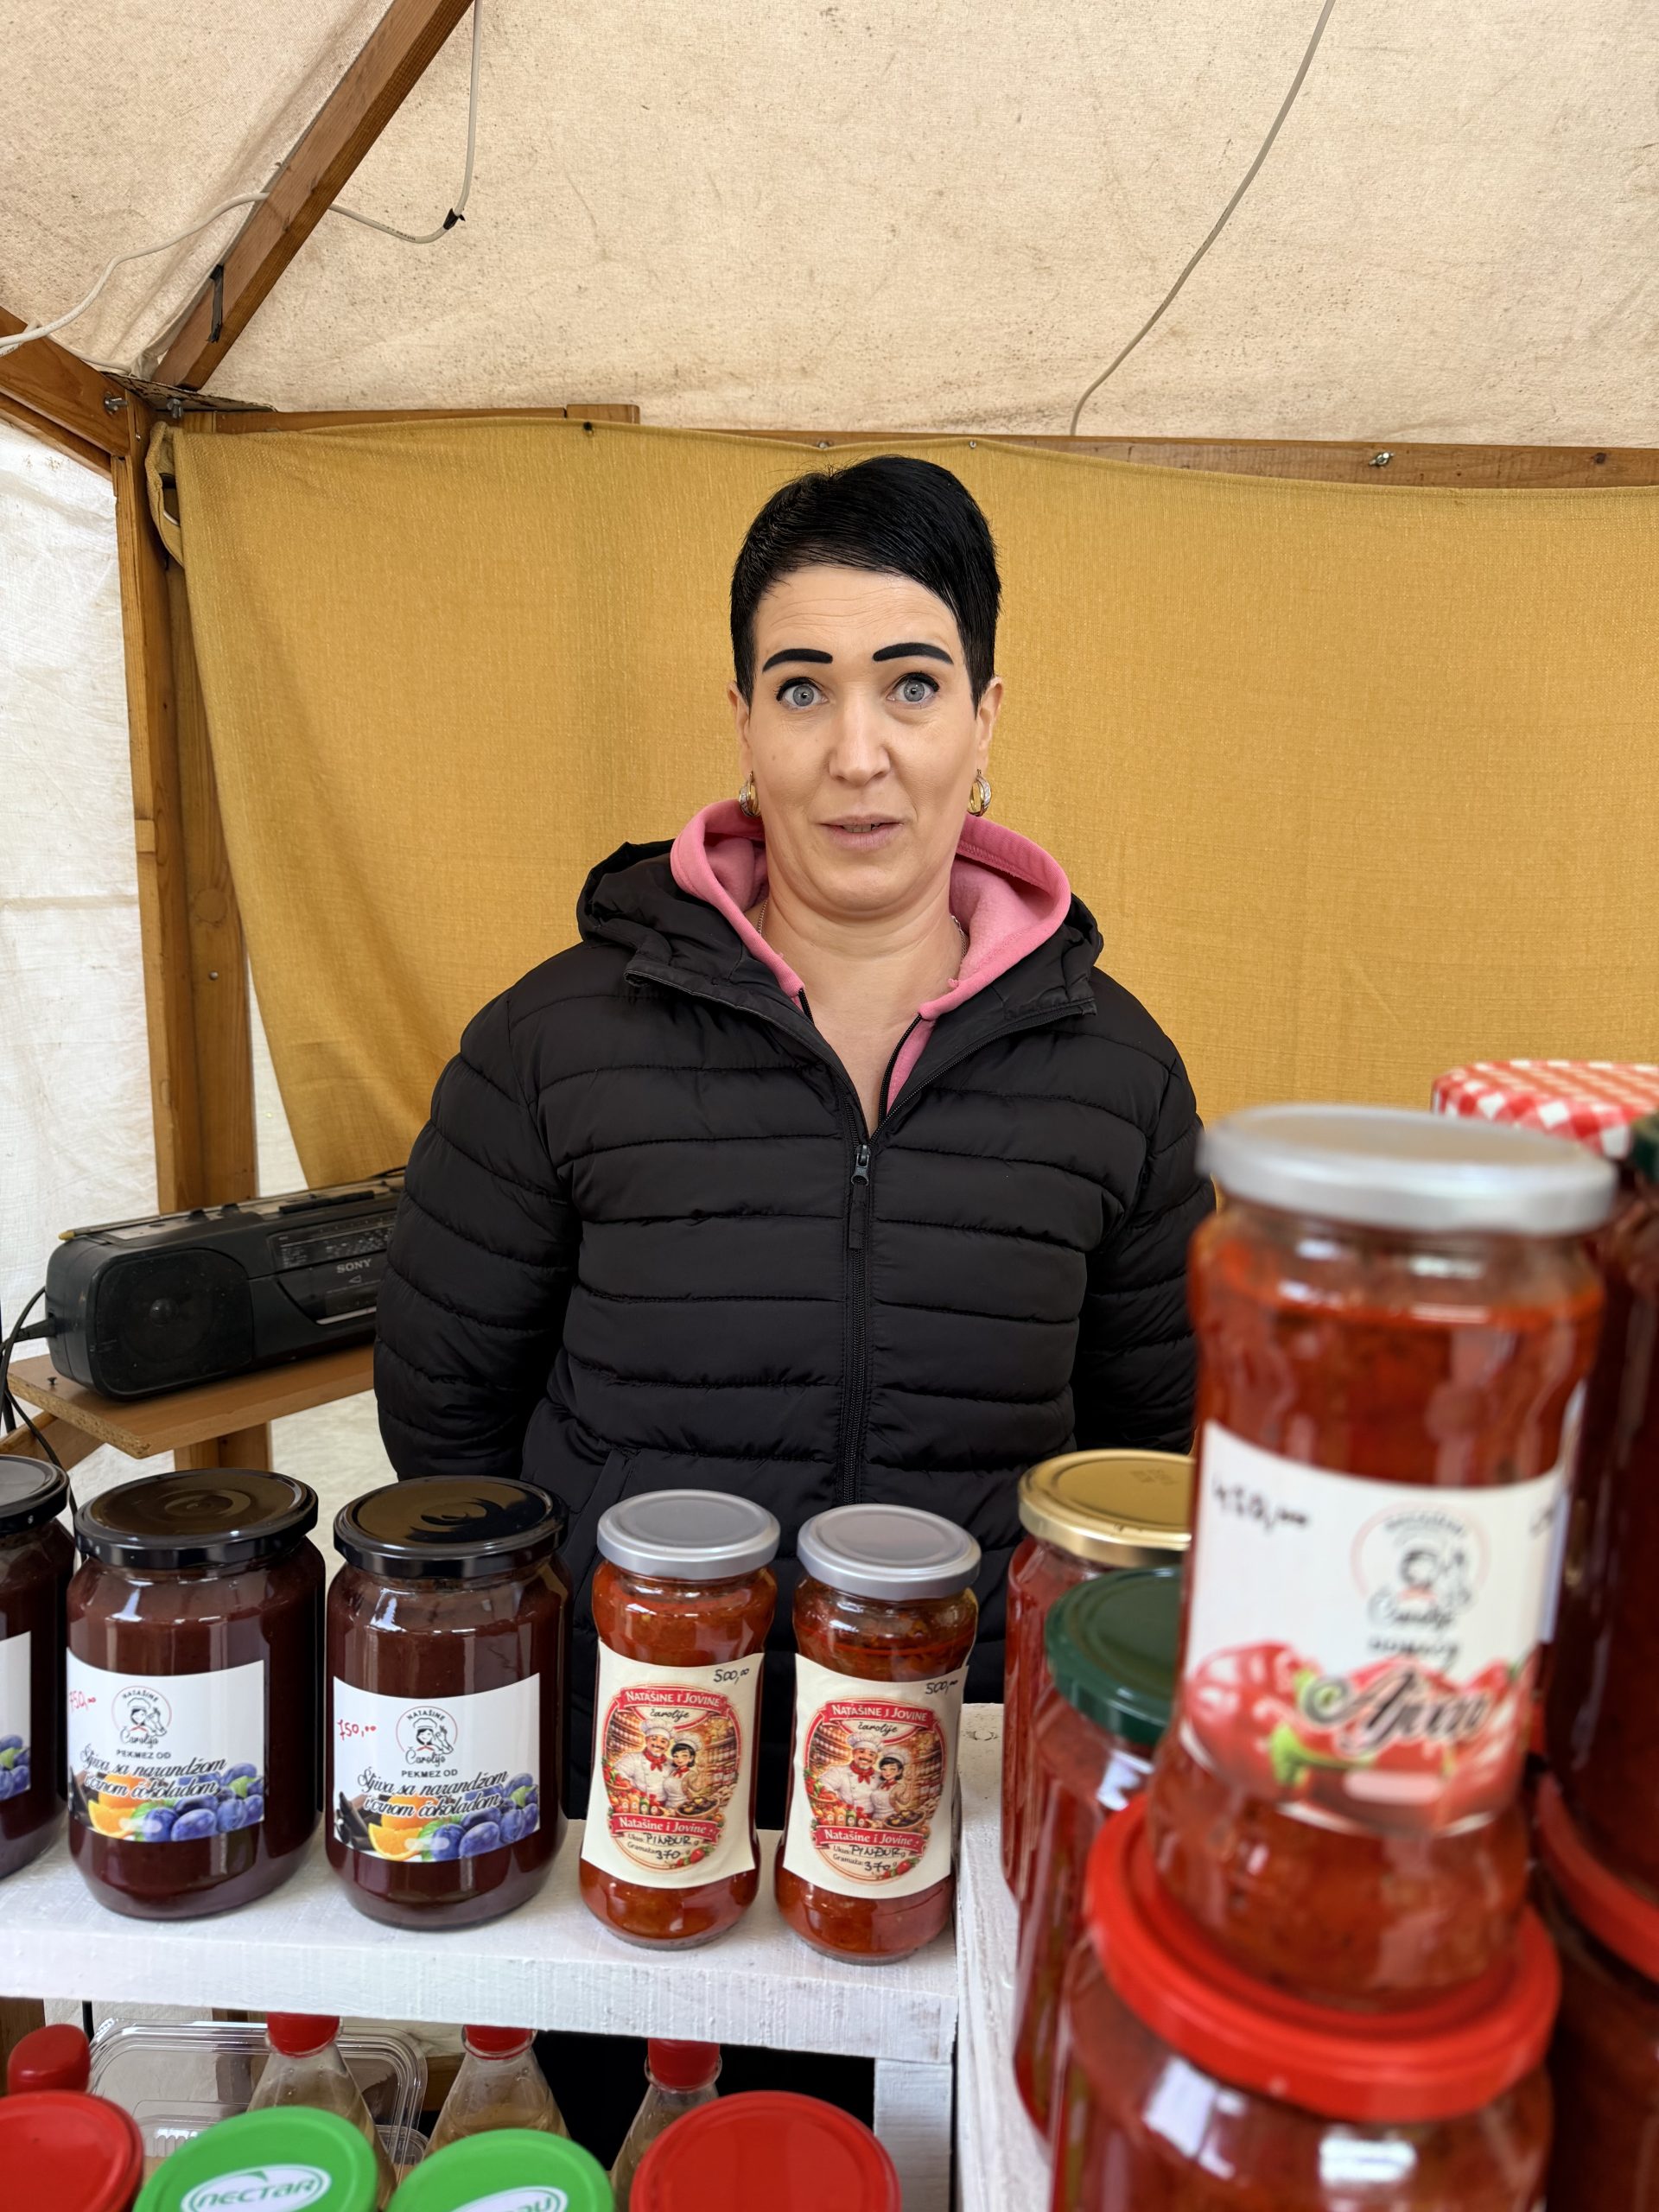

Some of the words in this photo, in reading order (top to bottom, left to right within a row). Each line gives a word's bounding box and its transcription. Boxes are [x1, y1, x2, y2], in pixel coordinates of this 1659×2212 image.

[336, 1258, 372, 1274] SONY
[625, 1690, 673, 1702] NATAŠINE
[682, 1693, 721, 1707] JOVINE
[406, 1709, 446, 1721] NATAŠINE
[831, 1704, 881, 1717] NATAŠINE
[891, 1707, 927, 1721] JOVINE
[401, 1770, 441, 1778] PEKMEZ
[443, 1768, 458, 1777] OD
[396, 1783, 415, 1796] sa
[419, 1770, 509, 1796] narandžom
[618, 1816, 664, 1831] Natašine
[665, 1822, 671, 1831] i
[673, 1821, 707, 1834] Jovine
[823, 1828, 871, 1843] Natašine
[873, 1834, 879, 1843] i
[880, 1833, 913, 1846] Jovine
[656, 1849, 681, 1859] 370
[864, 1860, 891, 1872] 370
